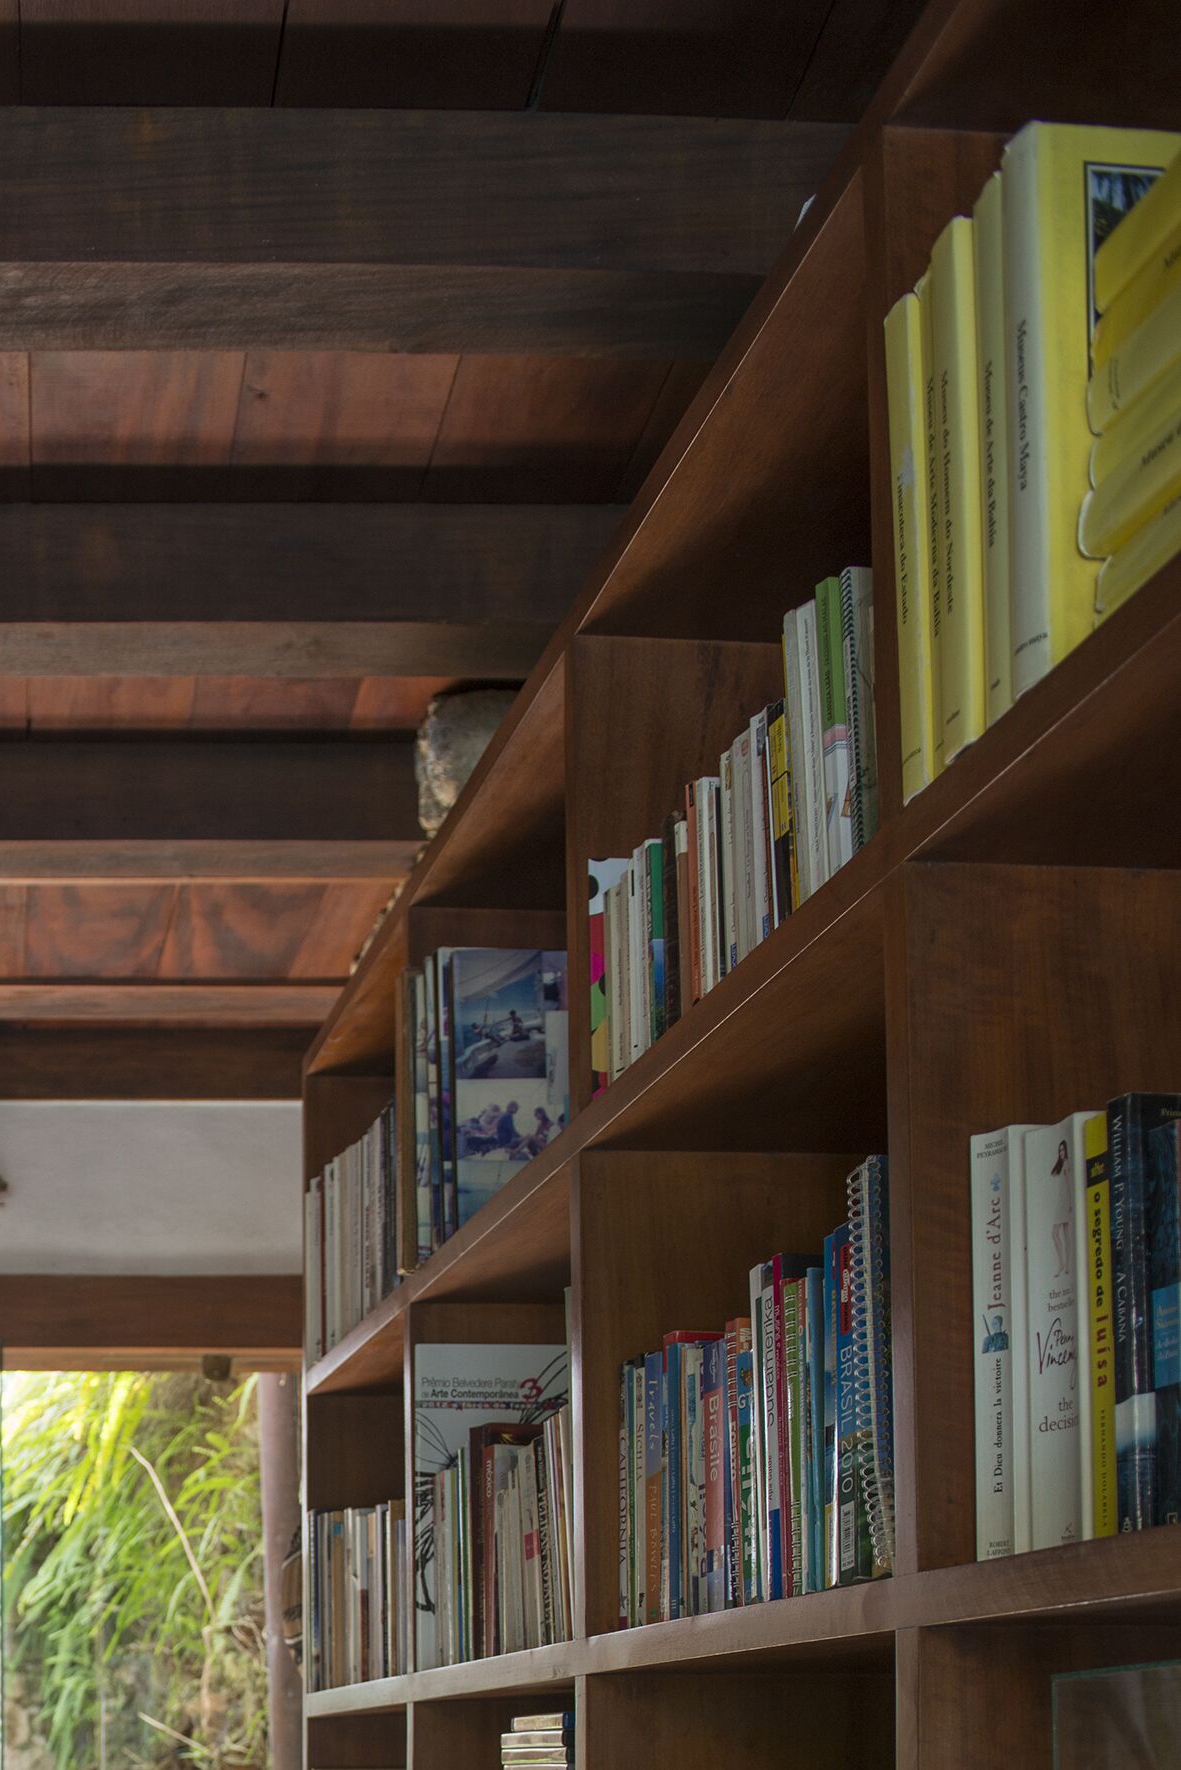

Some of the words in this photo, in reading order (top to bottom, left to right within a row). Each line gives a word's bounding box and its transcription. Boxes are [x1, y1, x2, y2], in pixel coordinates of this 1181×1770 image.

[1016, 320, 1028, 384] Museus
[940, 371, 949, 426] Museu
[985, 362, 994, 416] Museu
[986, 420, 995, 437] de
[1018, 386, 1030, 441] Castro
[942, 430, 951, 449] do
[987, 442, 996, 474] Arte
[942, 453, 952, 517] Homem
[988, 479, 997, 499] da
[1018, 442, 1030, 492] Maya
[945, 520, 954, 540] do
[988, 501, 998, 549] Bahia
[1112, 1114, 1125, 1177] WILLIAM
[1094, 1191, 1101, 1203] o
[985, 1197, 1001, 1246] d'Arc
[1093, 1209, 1105, 1280] segredo
[1114, 1197, 1126, 1251] YOUNG
[987, 1251, 1006, 1310] Jeanne
[1096, 1285, 1105, 1308] de
[1116, 1271, 1126, 1283] A
[1117, 1285, 1129, 1343] CABANA
[1097, 1314, 1110, 1388] luísa
[430, 1389, 450, 1400] Arte
[450, 1389, 520, 1402] Contemporânea
[451, 1378, 493, 1390] Belvedere
[519, 1377, 545, 1402] 3
[839, 1346, 855, 1433] BRASIL
[993, 1358, 1002, 1395] victoire
[647, 1380, 660, 1450] Travels
[993, 1398, 1002, 1407] la
[1058, 1397, 1074, 1412] the
[708, 1395, 721, 1481] Brasile
[993, 1411, 1003, 1448] donnera
[840, 1440, 856, 1494] 2010
[994, 1453, 1003, 1478] Dieu
[994, 1482, 1003, 1493] Et
